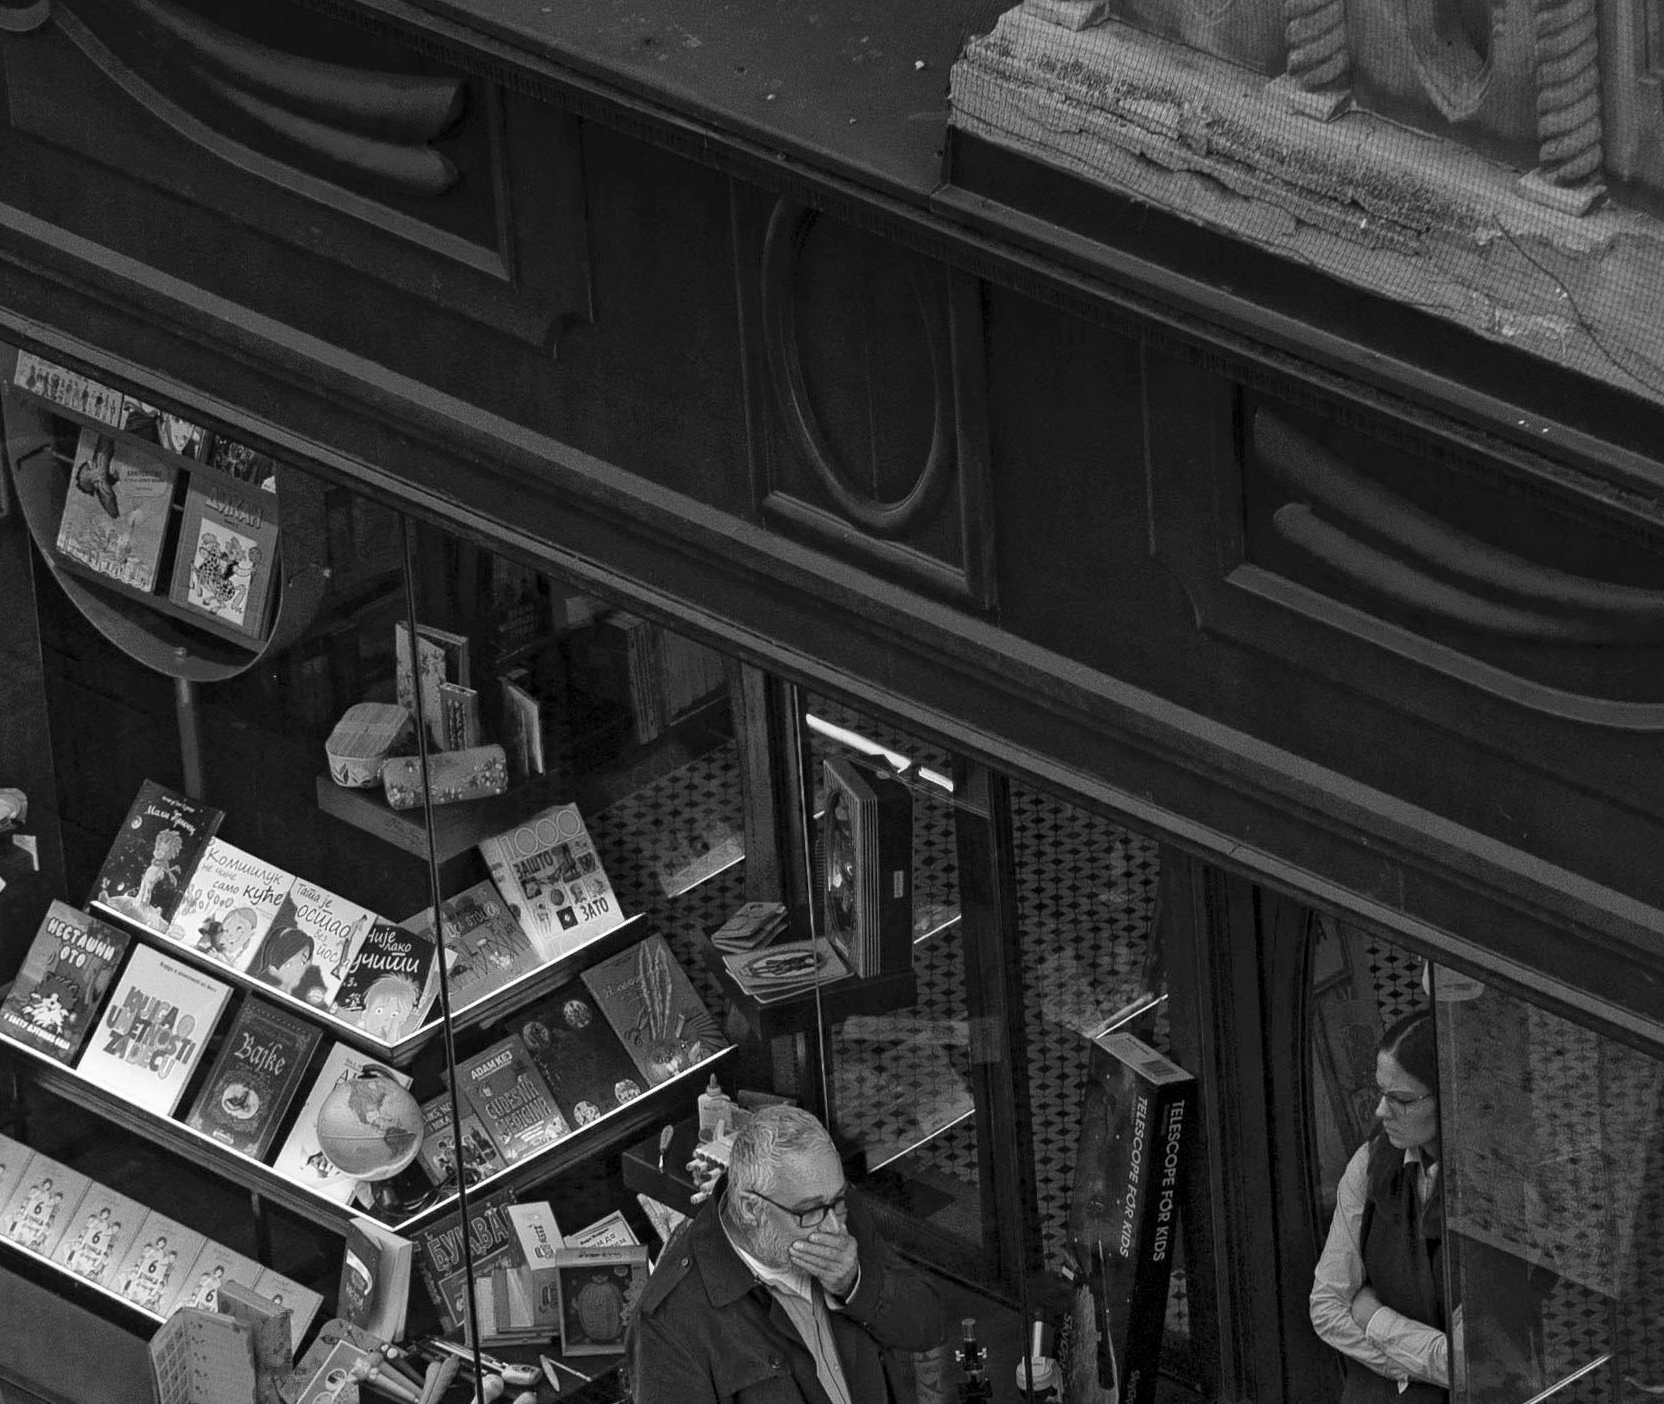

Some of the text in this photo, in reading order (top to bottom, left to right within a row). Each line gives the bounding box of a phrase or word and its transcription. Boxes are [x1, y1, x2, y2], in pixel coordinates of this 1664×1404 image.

[207, 847, 284, 886] Комшилук
[580, 897, 609, 922] ЗАТО
[60, 946, 87, 968] ОТО
[234, 1032, 286, 1076] Bajke
[471, 1058, 496, 1080] ADAM
[1119, 1095, 1148, 1259] TELESCOPE FOR KIDS
[1152, 1099, 1186, 1263] TELESCOPE FOR KIDS
[33, 1201, 45, 1215] 6
[91, 1231, 103, 1245] 6
[148, 1259, 160, 1274] 6
[205, 1289, 216, 1303] 6
